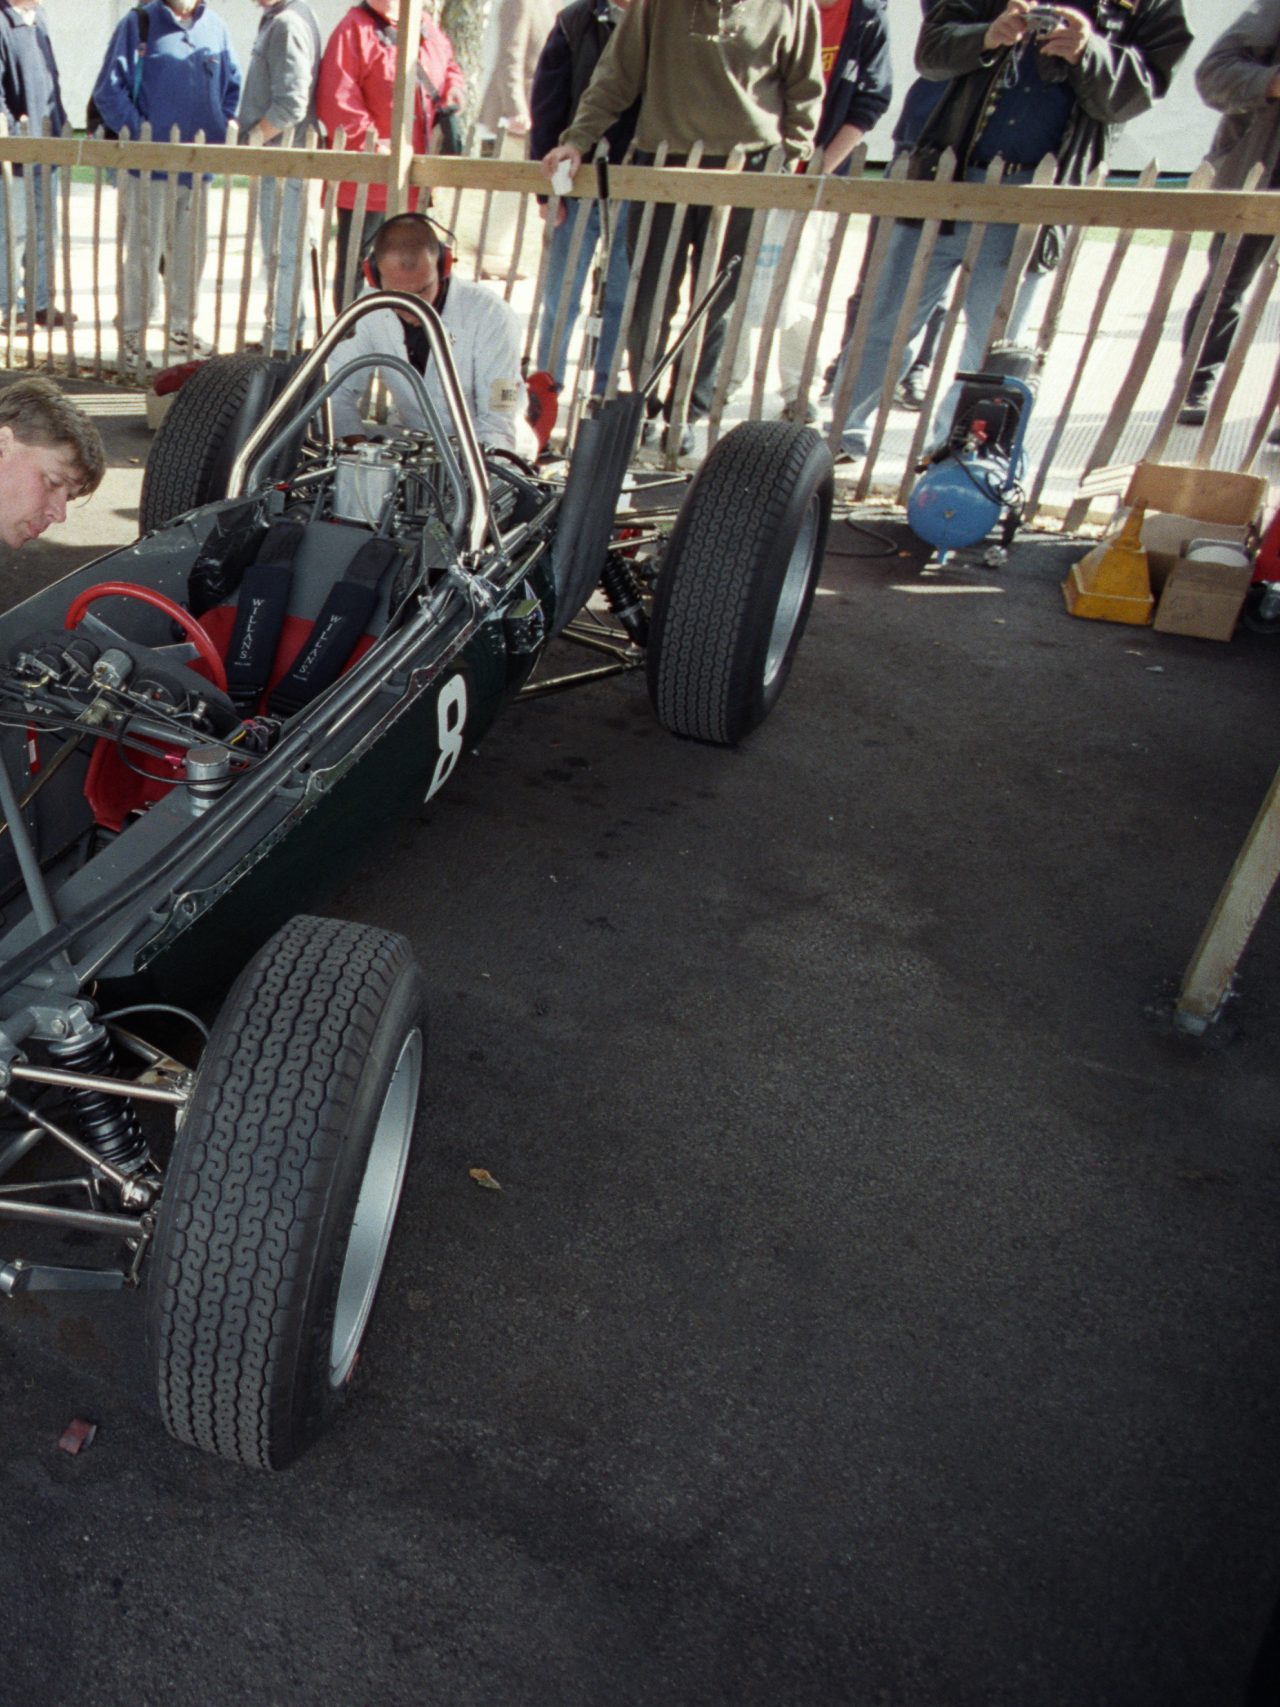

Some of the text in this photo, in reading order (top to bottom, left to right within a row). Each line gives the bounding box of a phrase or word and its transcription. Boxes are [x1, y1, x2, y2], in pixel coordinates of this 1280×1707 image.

[239, 598, 265, 660] WILLANS
[298, 614, 342, 674] WILLANS
[423, 673, 468, 804] 8
